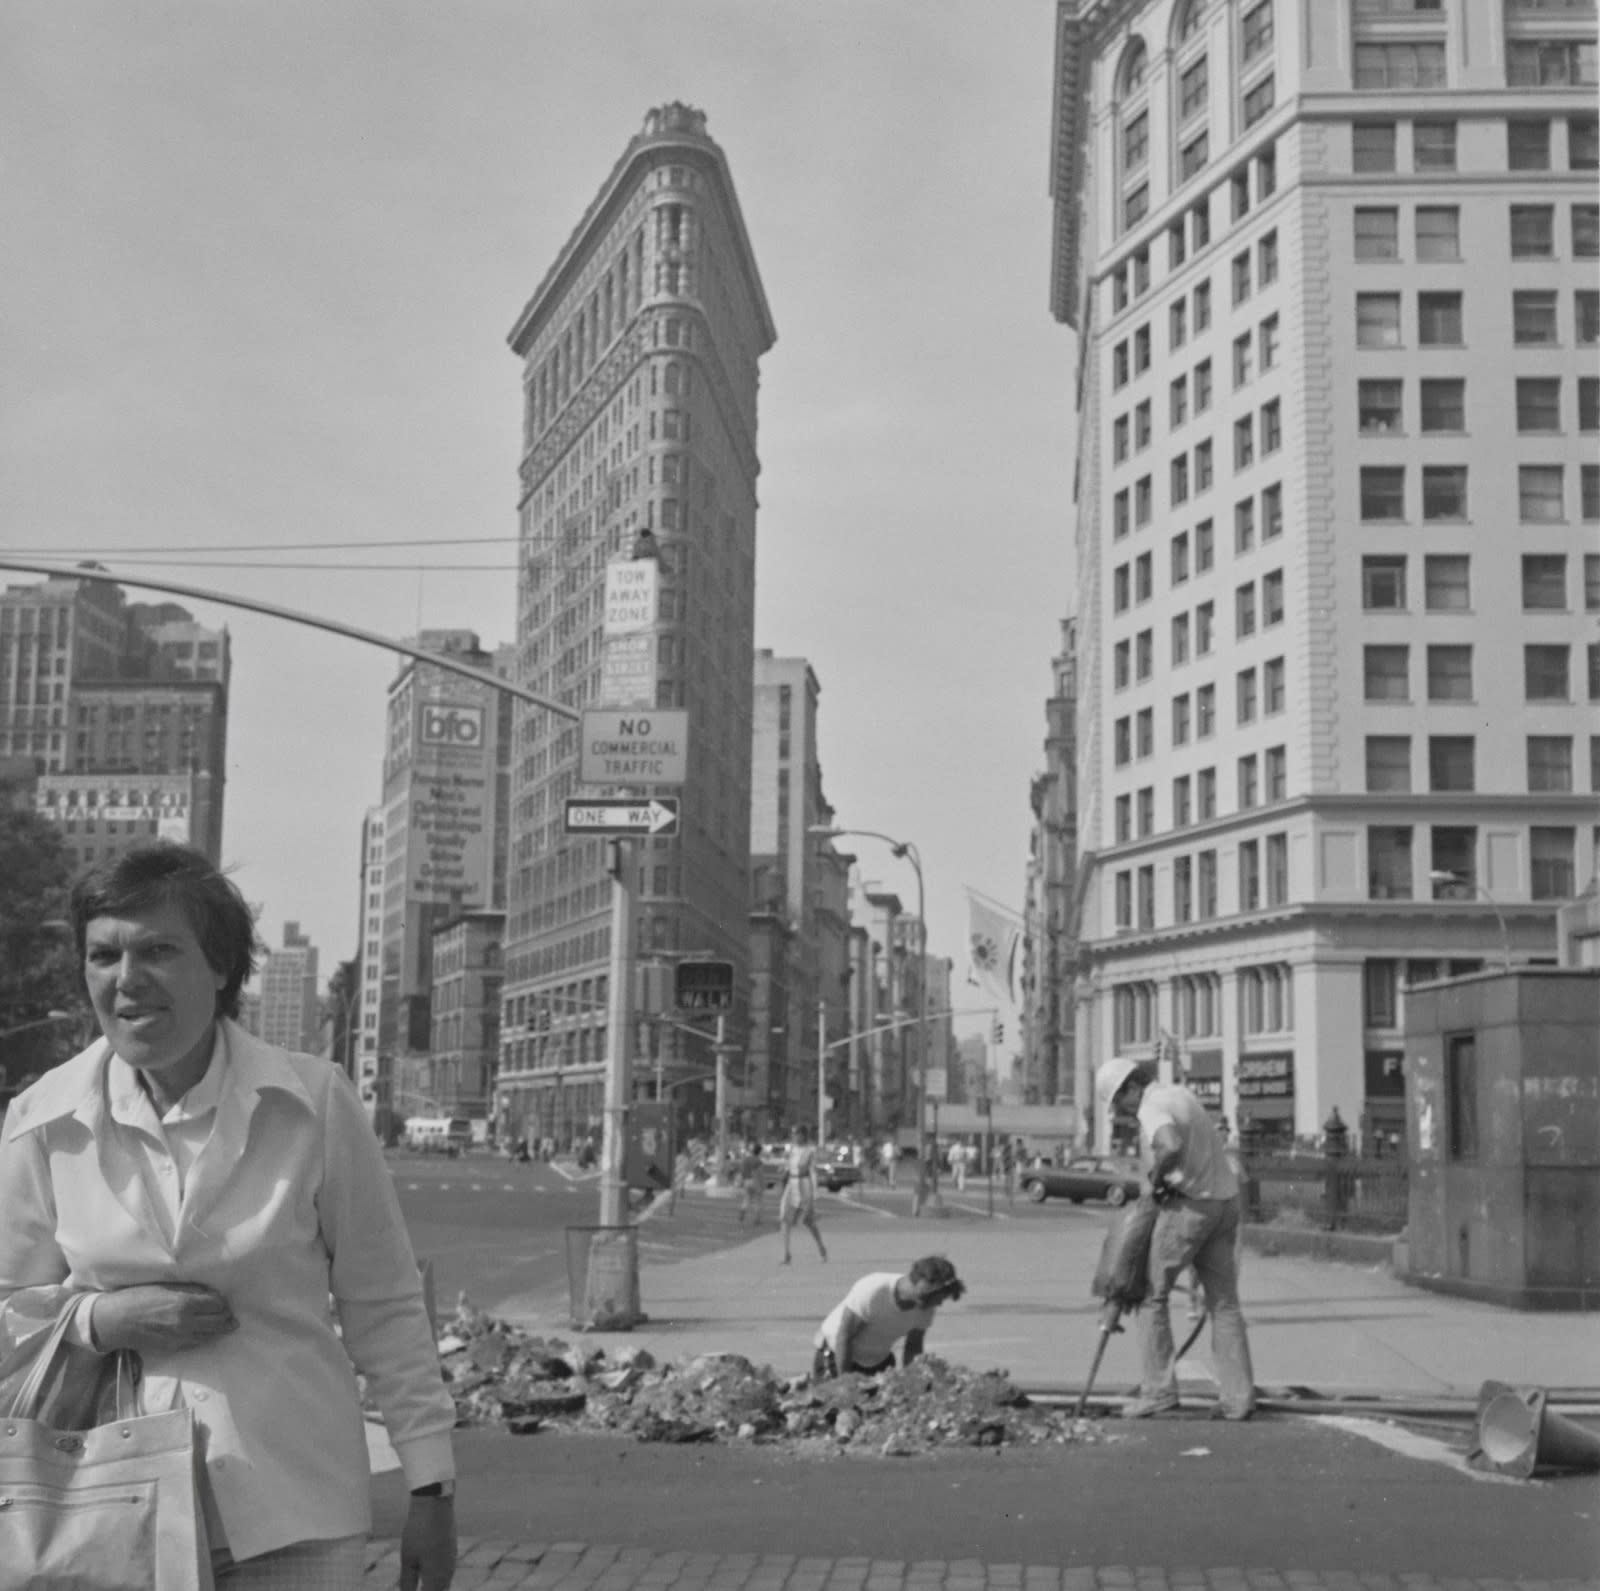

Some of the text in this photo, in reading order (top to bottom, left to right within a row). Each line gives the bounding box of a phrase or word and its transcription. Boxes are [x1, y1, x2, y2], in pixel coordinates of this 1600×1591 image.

[616, 569, 646, 584] TOW
[609, 588, 652, 601] AWAY
[609, 607, 649, 622] ZONE
[426, 709, 477, 741] bfo
[619, 719, 651, 736] NO
[592, 741, 678, 756] COMMERCIAL
[604, 760, 663, 775] TRAFFIC
[573, 809, 662, 824] ONE WAY
